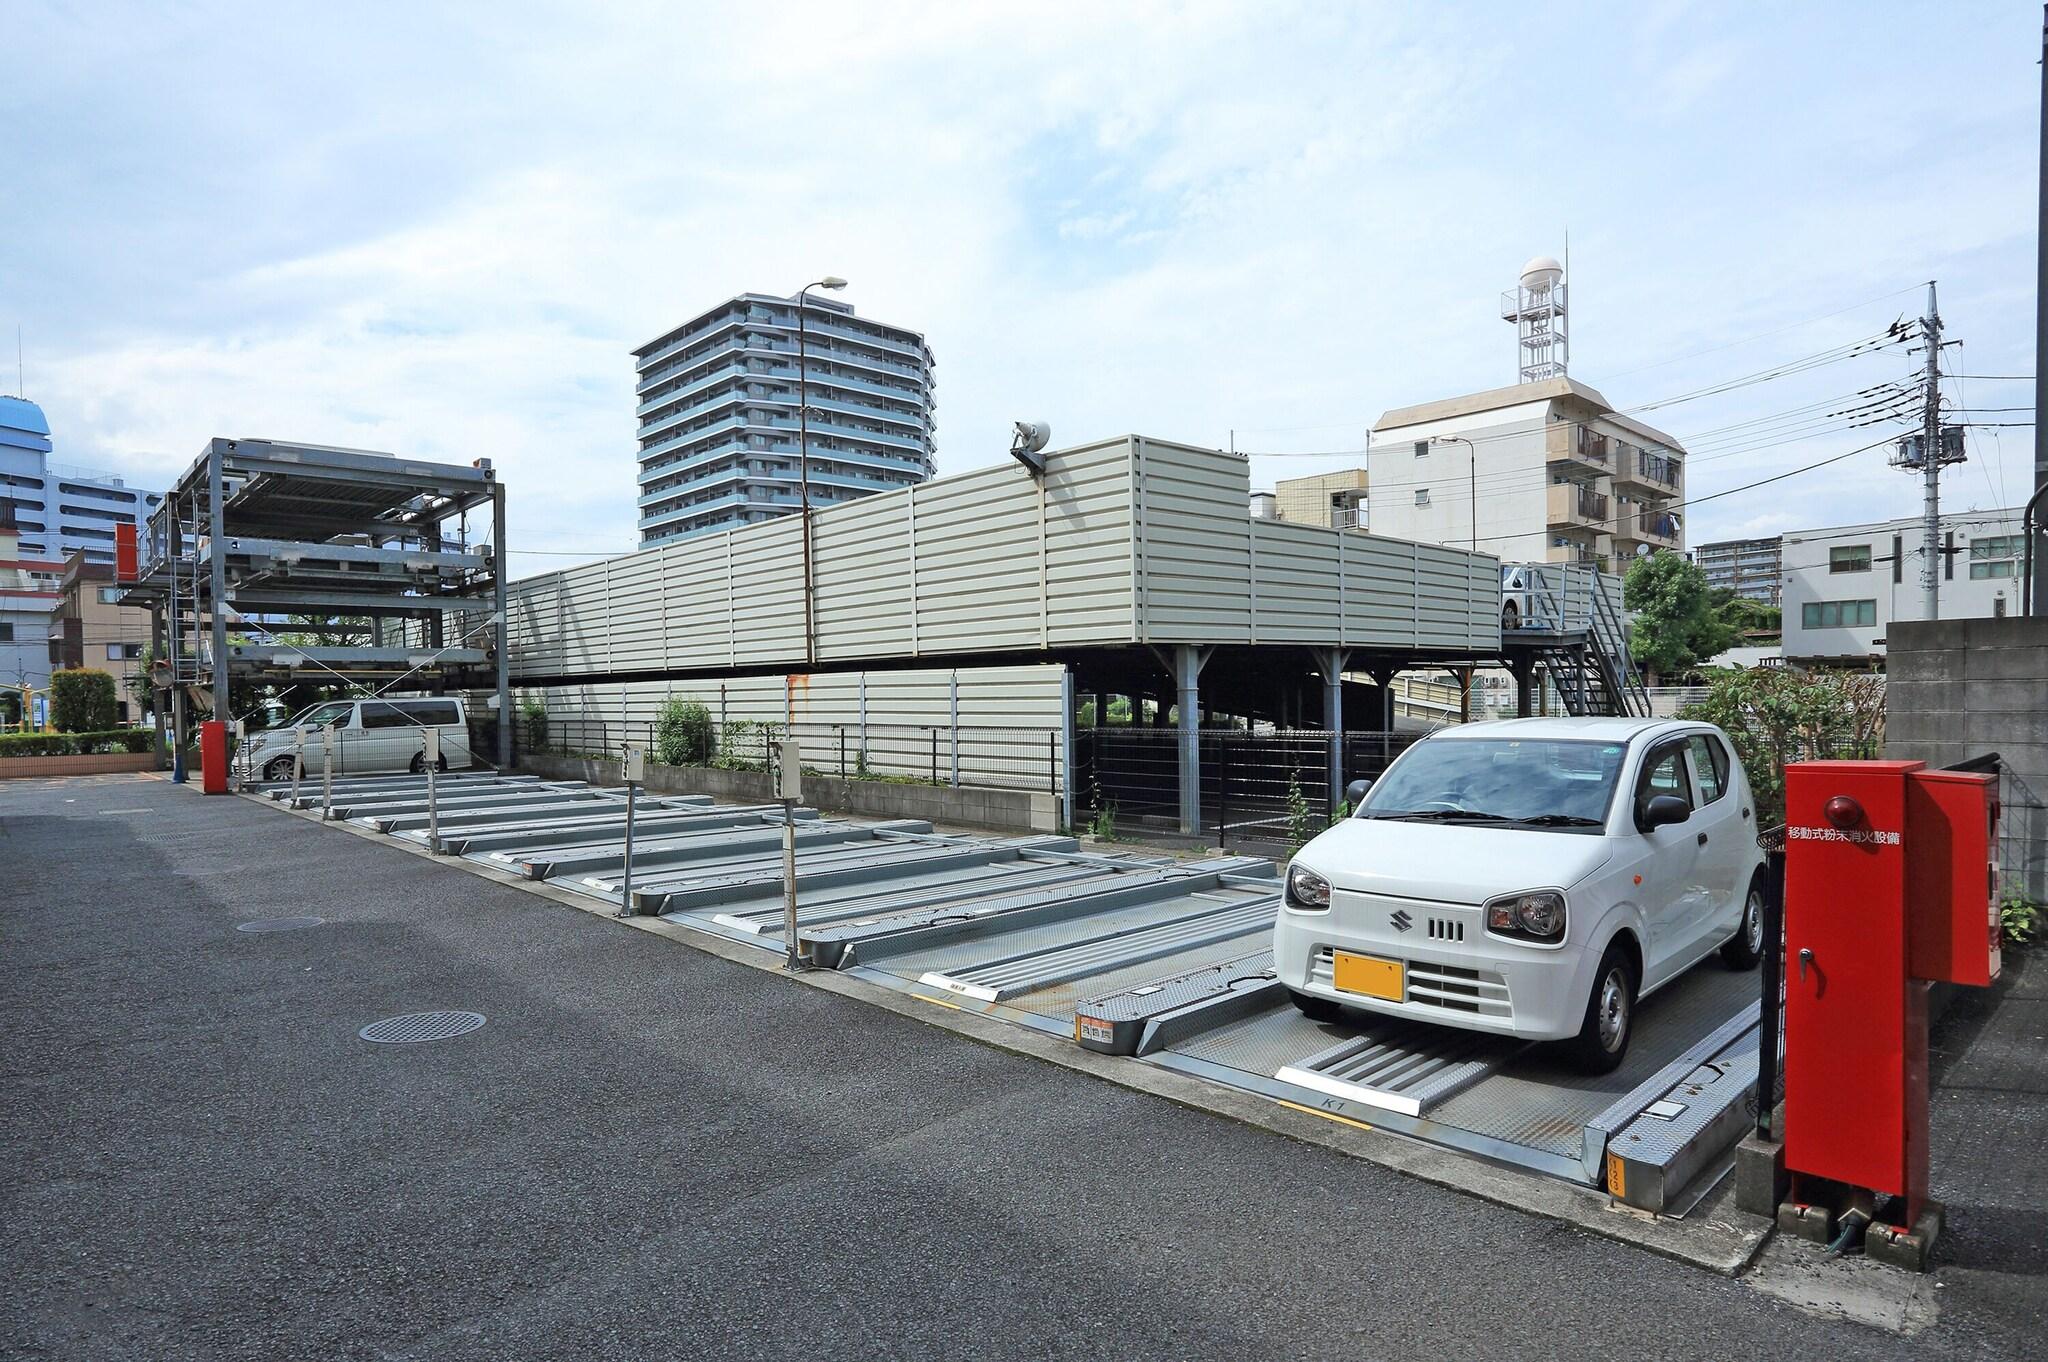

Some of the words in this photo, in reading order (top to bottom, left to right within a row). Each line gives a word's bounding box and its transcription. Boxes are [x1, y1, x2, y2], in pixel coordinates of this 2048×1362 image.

[1787, 826, 1900, 845] 移動式粉末消火設備
[1321, 1098, 1346, 1111] K1
